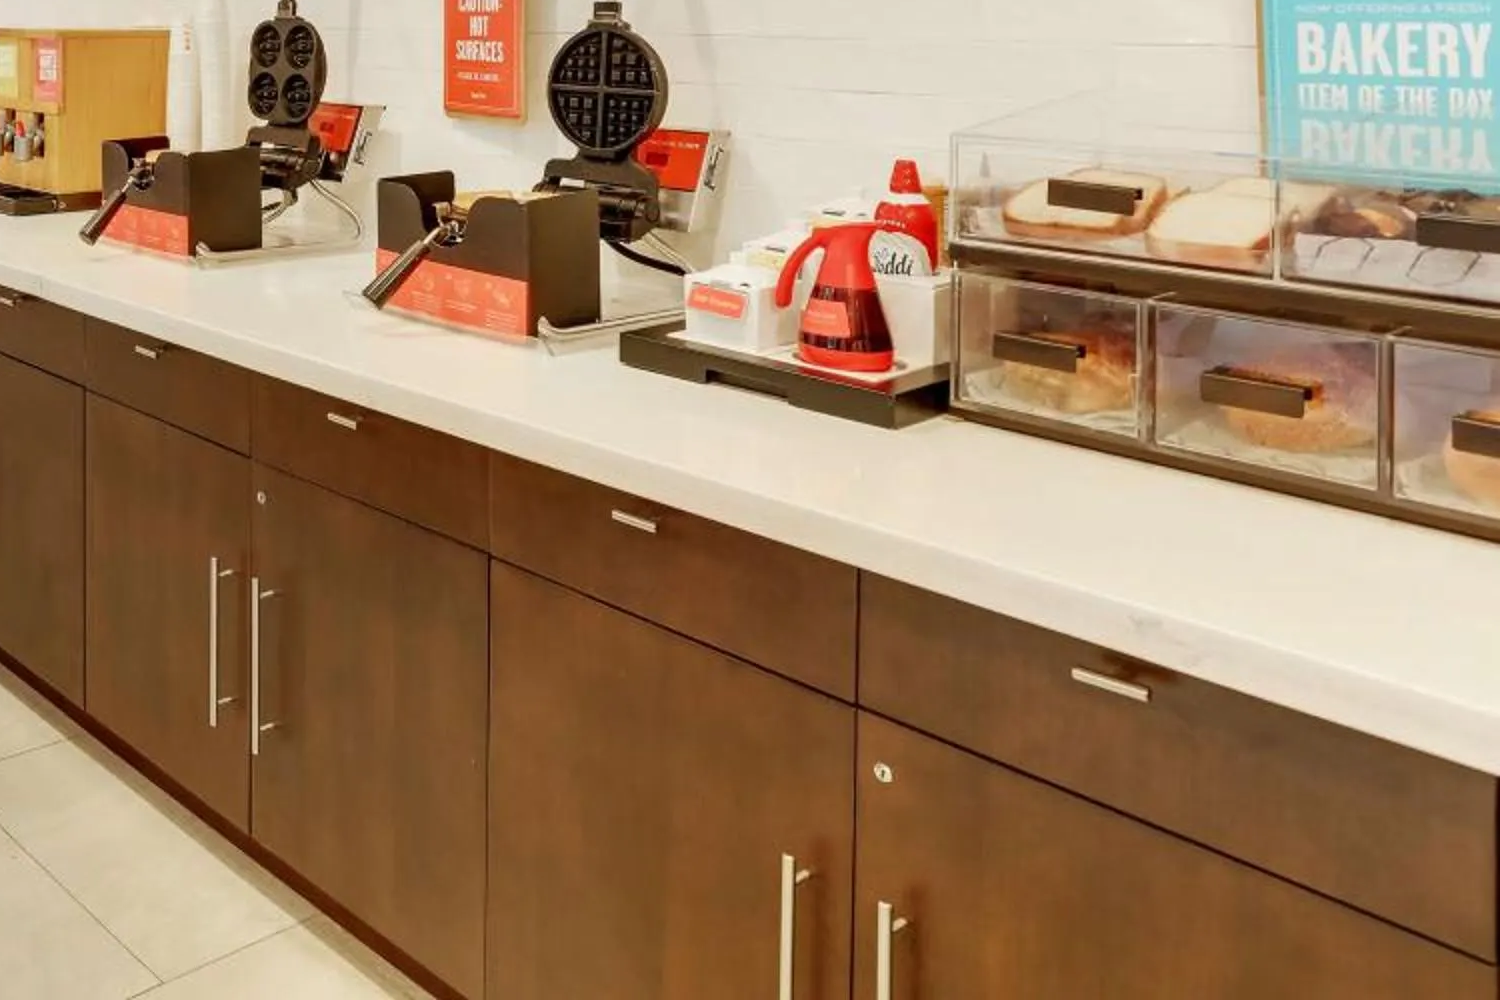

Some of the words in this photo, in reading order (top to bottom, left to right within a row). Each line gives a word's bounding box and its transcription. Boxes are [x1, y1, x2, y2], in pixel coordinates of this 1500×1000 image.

[469, 15, 488, 37] HOT
[455, 39, 504, 63] SURFACES
[1297, 20, 1493, 79] BAKERY
[1299, 82, 1349, 111] ITEM
[1358, 84, 1386, 114] OF
[1393, 85, 1438, 117] THE
[1449, 88, 1494, 120] DAY
